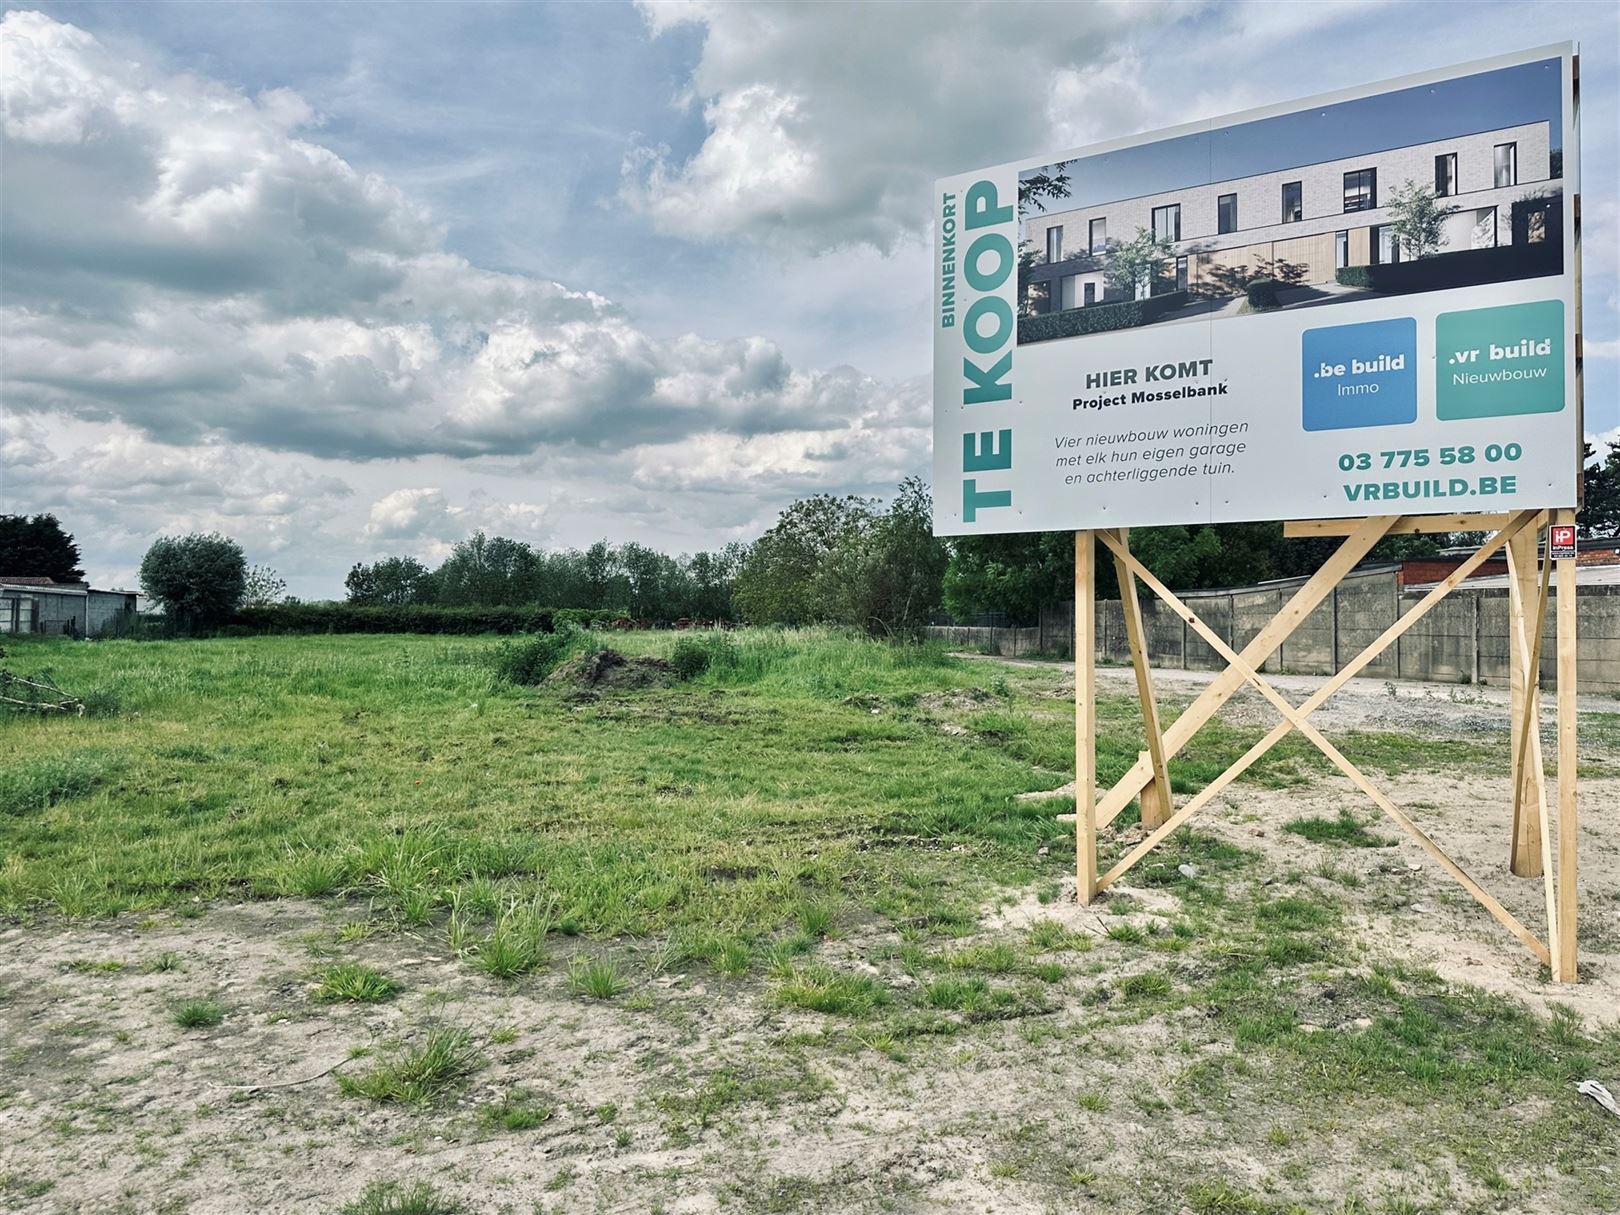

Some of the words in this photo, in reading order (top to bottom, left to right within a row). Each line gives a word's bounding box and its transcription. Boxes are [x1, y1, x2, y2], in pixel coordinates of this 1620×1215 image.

[942, 192, 956, 329] BINNENKORT
[963, 179, 1015, 405] KOOP
[1448, 347, 1480, 365] .vr
[1489, 338, 1551, 361] build
[1086, 368, 1138, 390] HIER
[1145, 359, 1213, 382] KOMT
[1313, 362, 1345, 378] .be
[1351, 354, 1405, 376] build
[1453, 366, 1548, 386] Nieuwbouw
[1072, 393, 1127, 410] Project
[1131, 382, 1228, 404] Mosselbank
[1337, 382, 1379, 397] Immo
[1055, 434, 1082, 449] Vier
[1086, 428, 1168, 447] nieuwbouw
[1173, 421, 1249, 439] woningen
[1056, 455, 1081, 467] met
[1086, 451, 1107, 465] elk
[1111, 449, 1138, 464] hun
[1142, 446, 1184, 464] eigen
[1189, 441, 1247, 459] garage
[1338, 452, 1371, 472] 03
[1380, 448, 1430, 469] 775
[1439, 446, 1475, 465] 58
[1484, 442, 1522, 463] 00
[963, 429, 1012, 523] TE
[1065, 474, 1082, 485] en
[1086, 464, 1198, 484] achterliggende
[1202, 462, 1235, 476] tuin.
[1343, 475, 1517, 502] VRBUILD.BE
